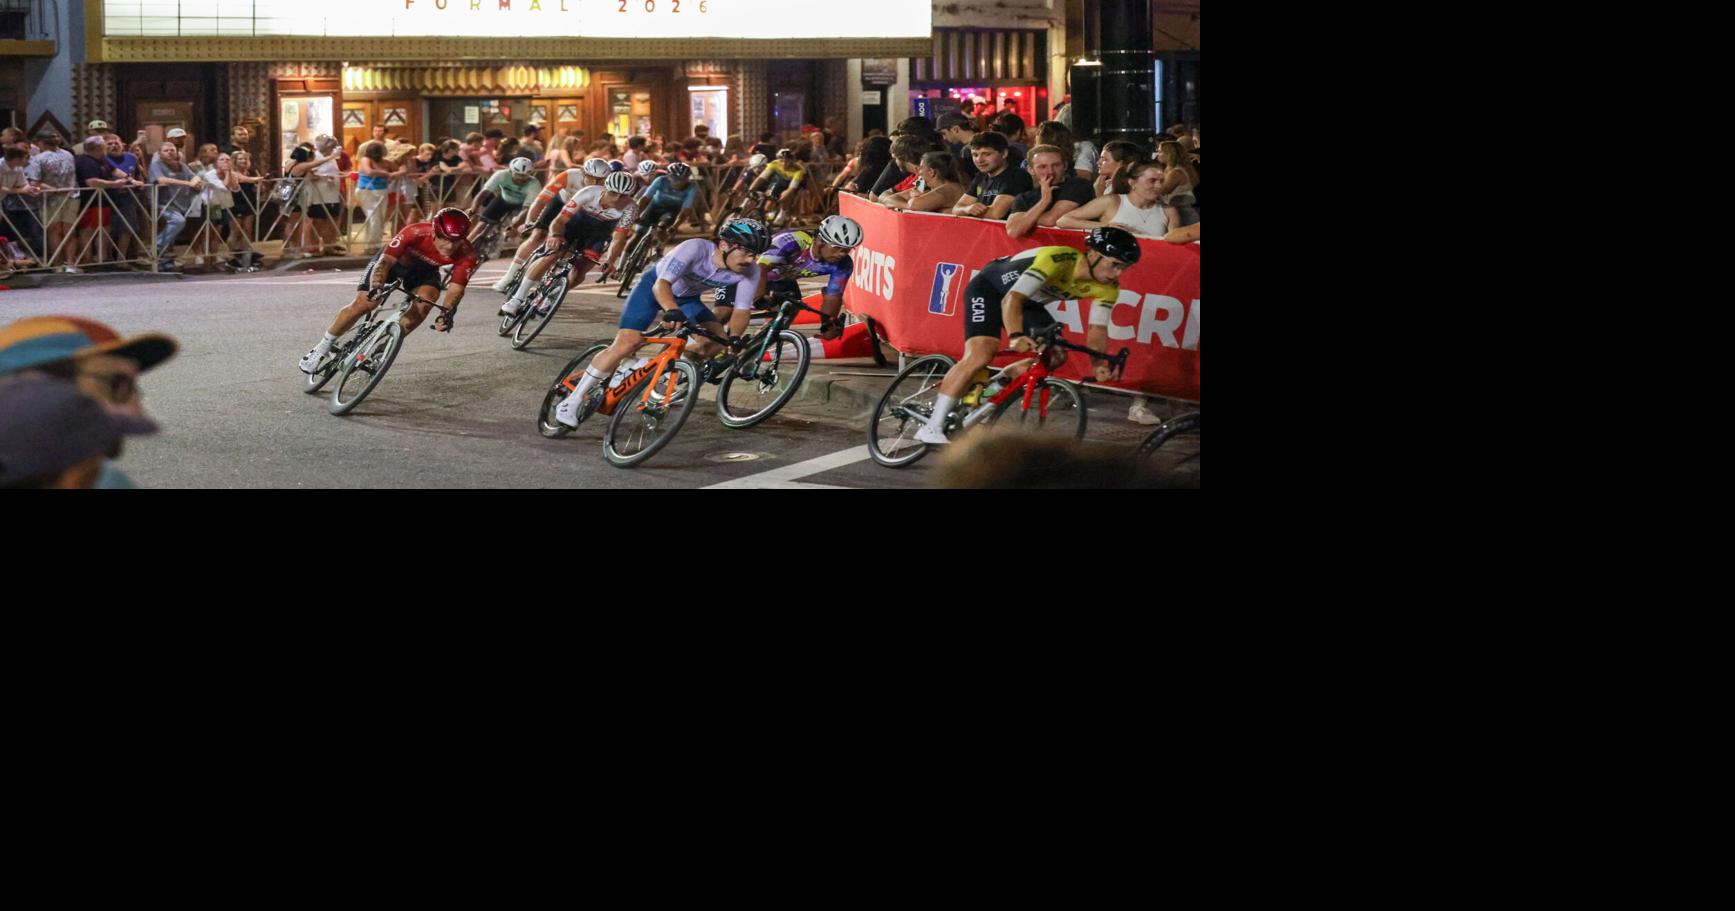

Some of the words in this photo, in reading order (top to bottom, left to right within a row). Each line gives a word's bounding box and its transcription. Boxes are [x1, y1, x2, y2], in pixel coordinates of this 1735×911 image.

[405, 0, 569, 12] FORMAL
[618, 0, 708, 13] 2026
[855, 245, 896, 301] CRITS
[1001, 270, 1020, 285] BEES
[971, 296, 985, 323] SCAD
